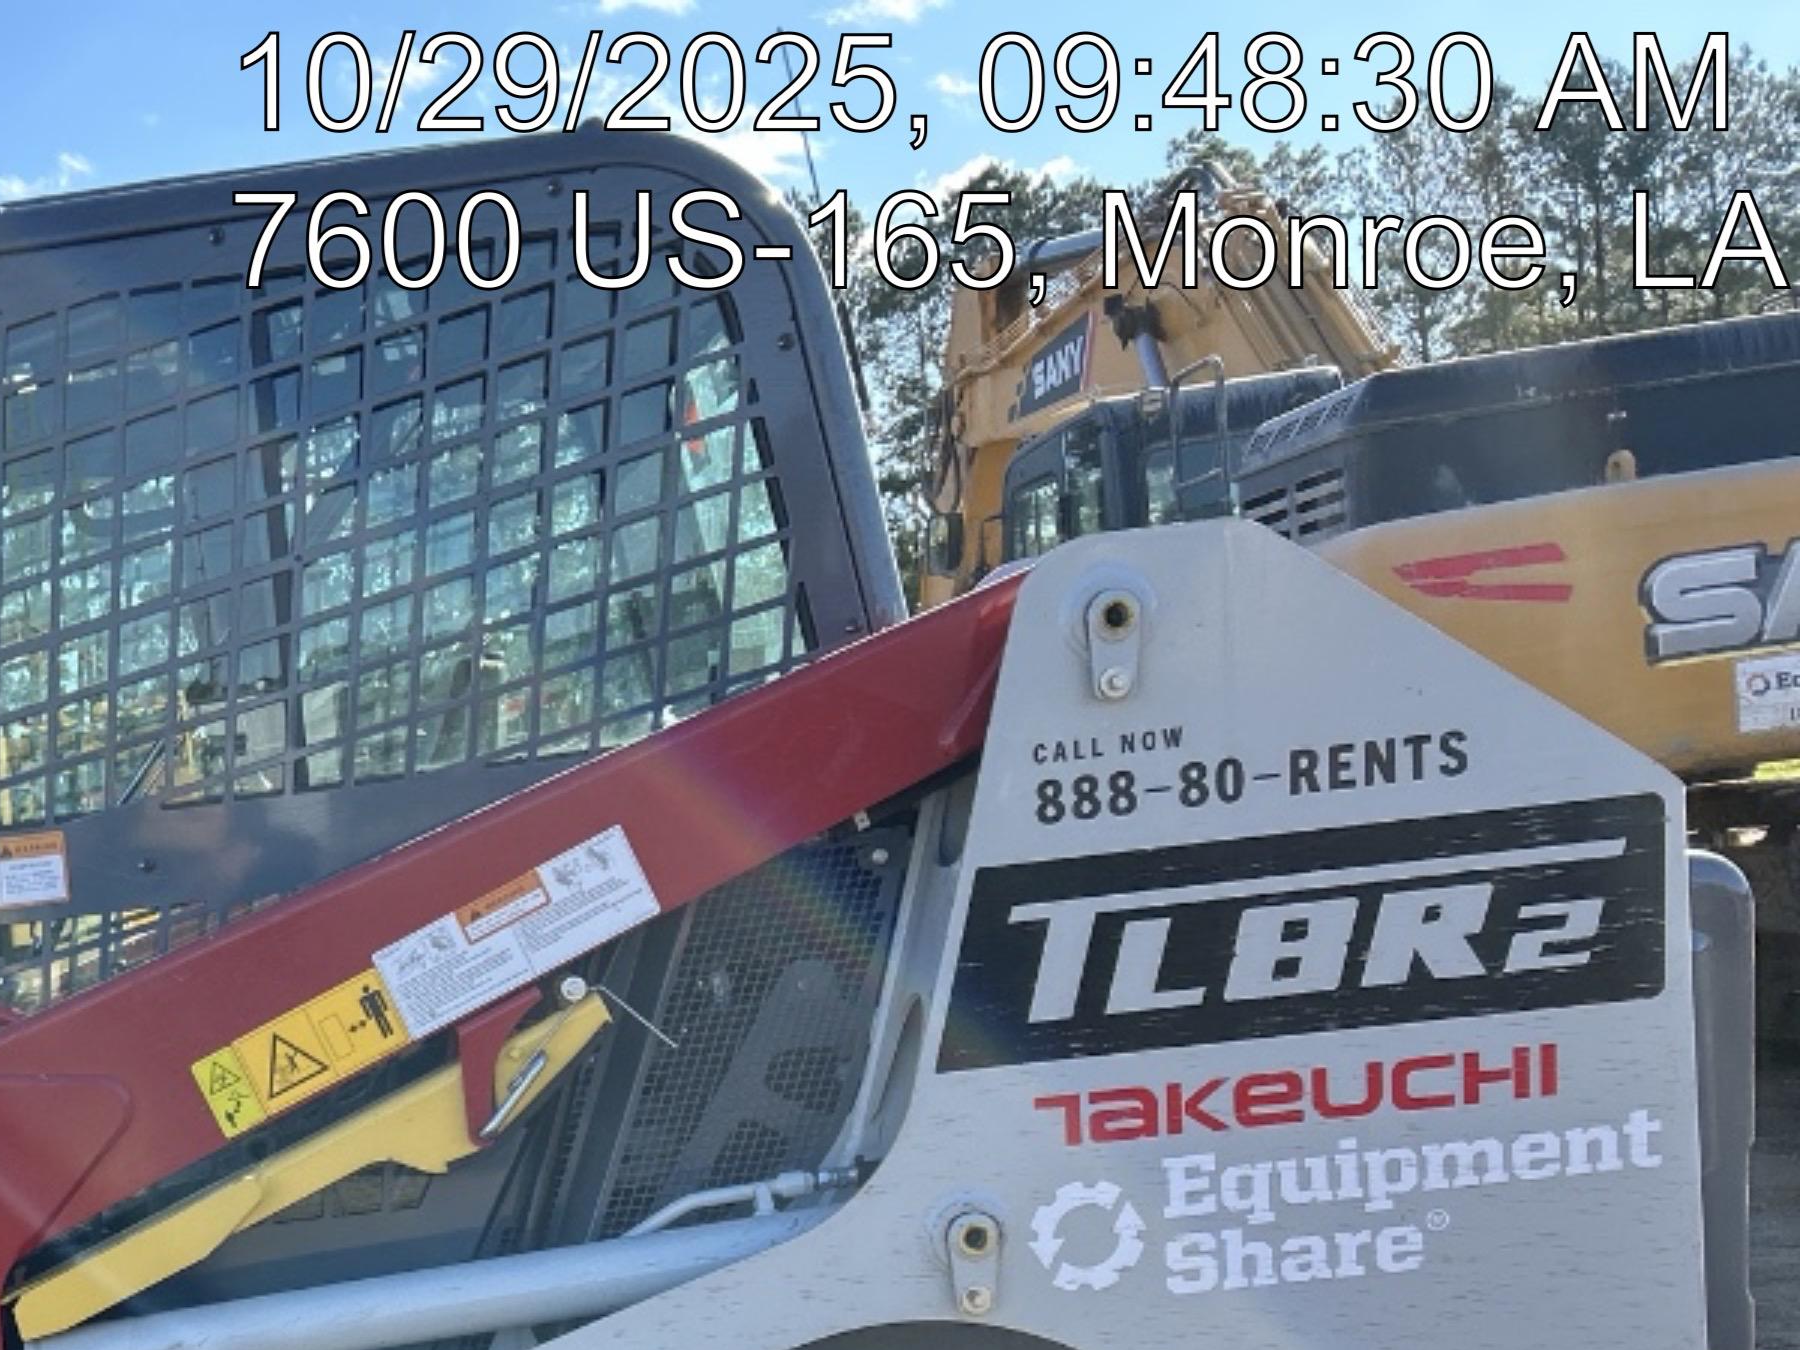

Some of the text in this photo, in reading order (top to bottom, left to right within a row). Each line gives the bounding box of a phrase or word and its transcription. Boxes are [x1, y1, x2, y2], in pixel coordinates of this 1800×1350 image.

[1032, 335, 1085, 400] SANY
[1032, 725, 1185, 765] CALL NOW
[1034, 729, 1470, 825] 888-80-RENTS
[1161, 1108, 1663, 1225] Equipment
[1163, 1223, 1426, 1296] Share
